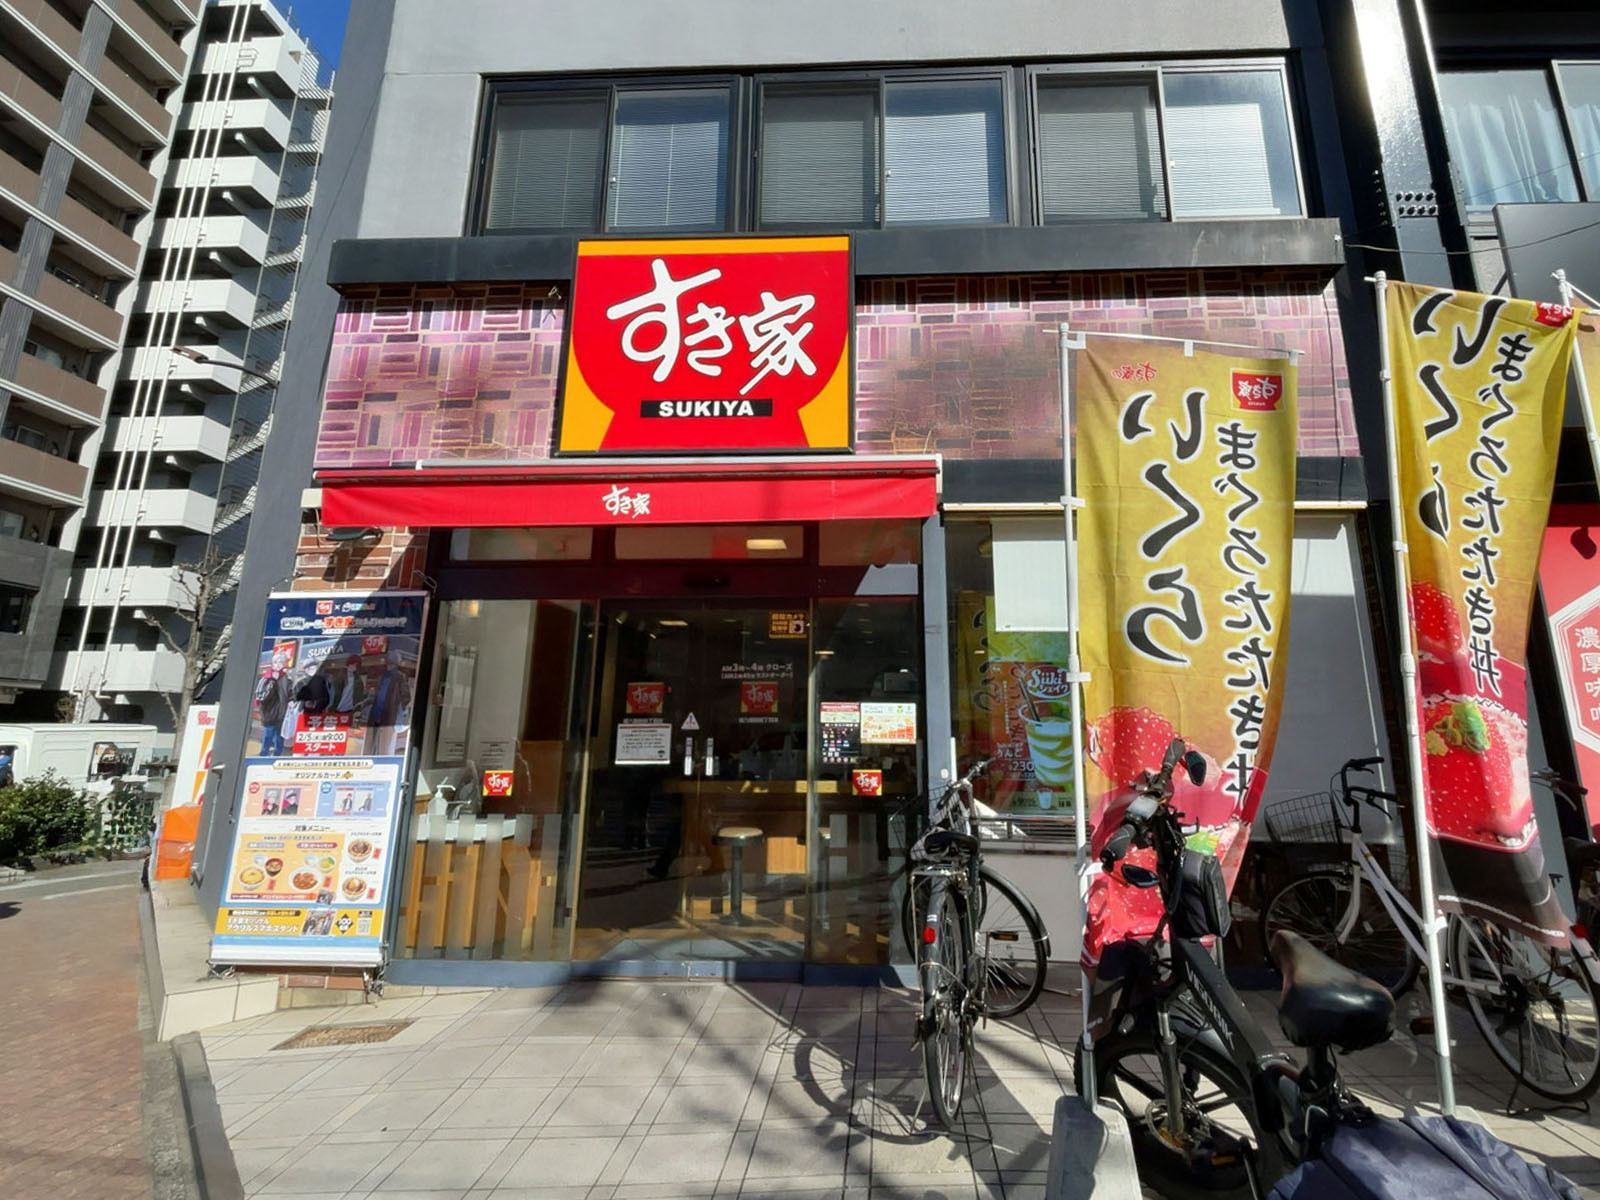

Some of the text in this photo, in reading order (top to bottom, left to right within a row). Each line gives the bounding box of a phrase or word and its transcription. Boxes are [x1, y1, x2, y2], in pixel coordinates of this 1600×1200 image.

[606, 258, 817, 395] すき家
[658, 401, 754, 417] SUKIYA
[602, 484, 650, 519] すき家
[304, 743, 336, 752] スタート
[295, 771, 341, 779] オリジナルカード
[294, 824, 331, 832] 対象メニュー
